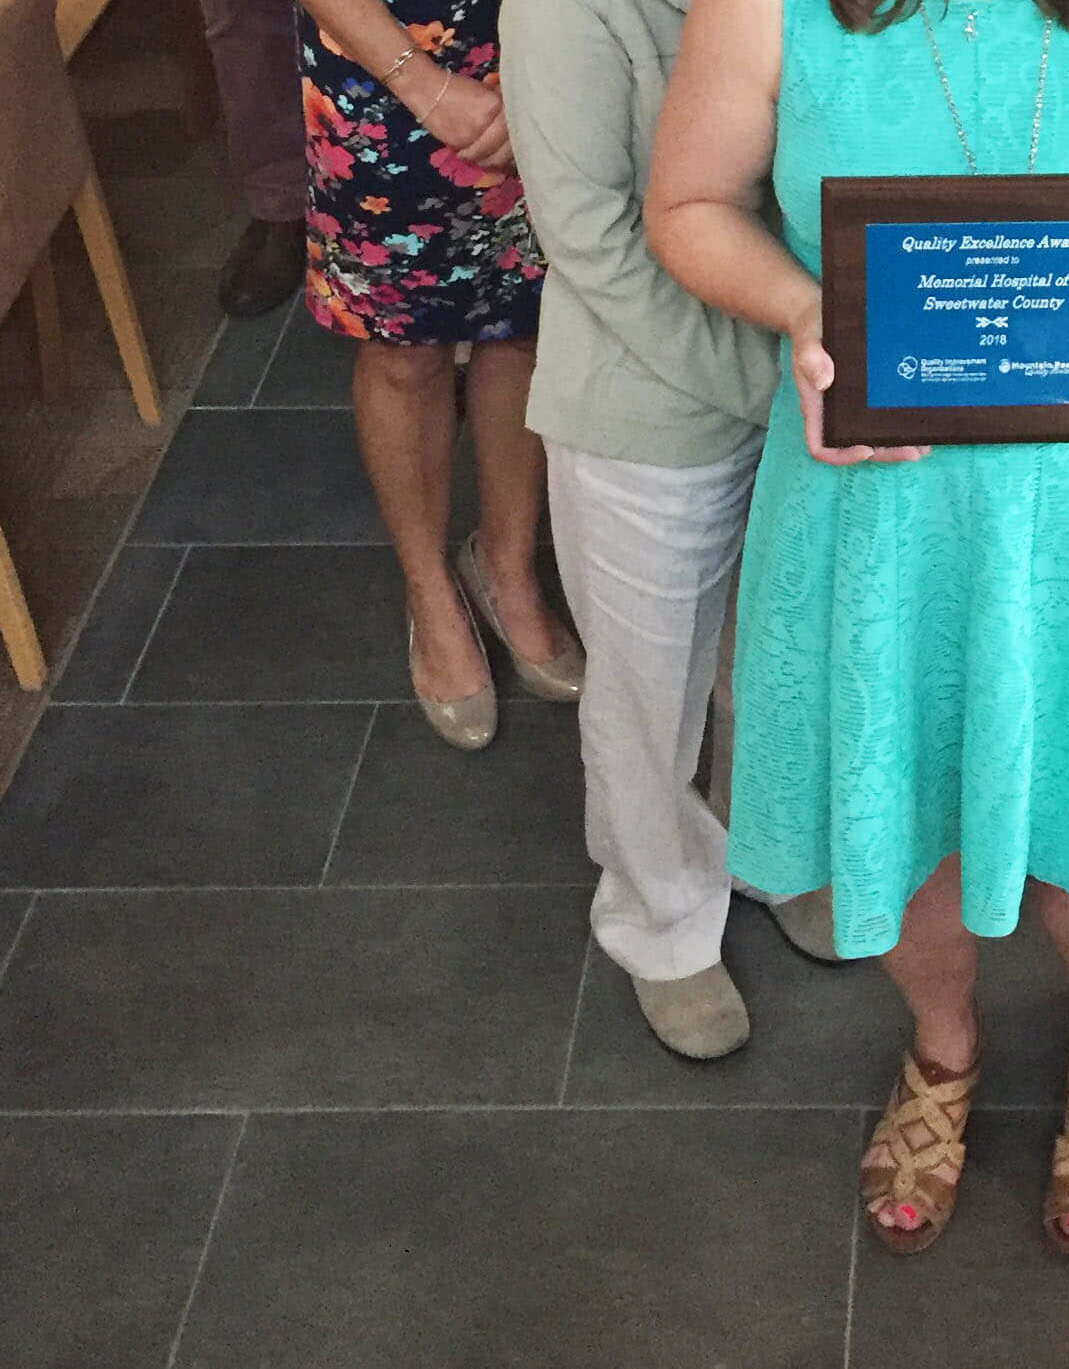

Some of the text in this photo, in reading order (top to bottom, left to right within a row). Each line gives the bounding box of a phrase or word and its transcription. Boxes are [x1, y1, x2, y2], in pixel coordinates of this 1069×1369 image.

[902, 236, 957, 252] Quality
[959, 235, 1035, 250] Excellence
[965, 256, 1020, 266] presented to
[917, 274, 989, 289] Memorial
[991, 273, 1052, 290] Hospital
[923, 295, 1066, 311] Sweetwater County
[979, 334, 1007, 346] 2018
